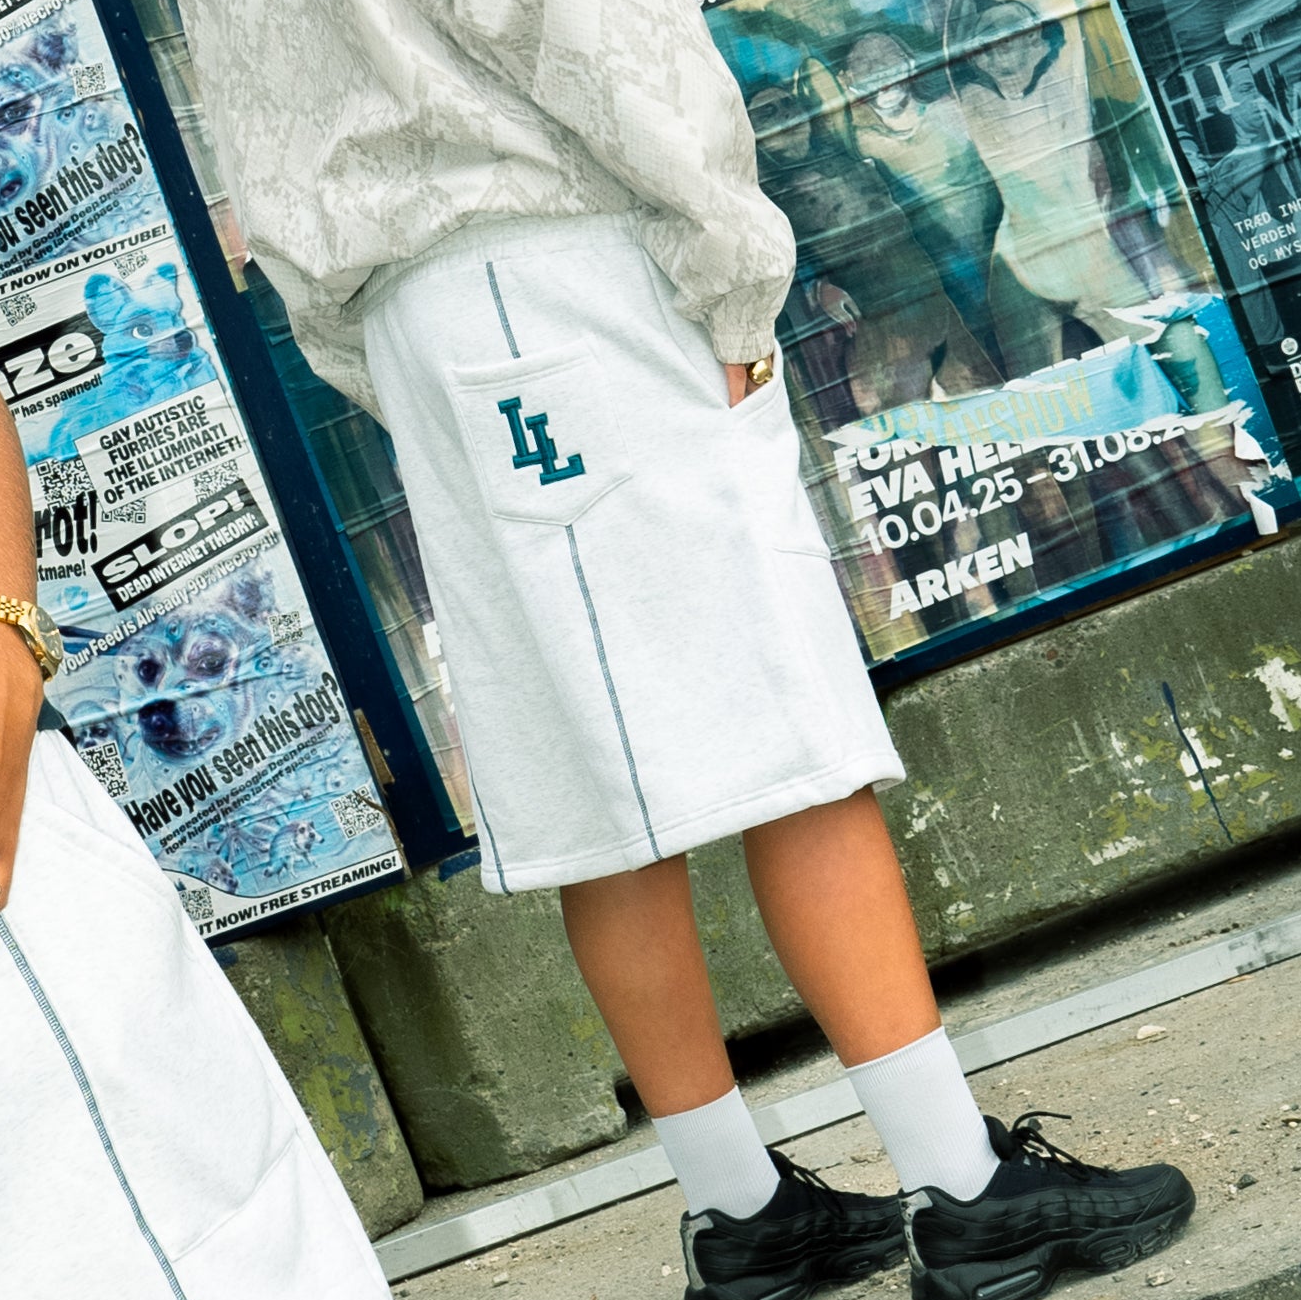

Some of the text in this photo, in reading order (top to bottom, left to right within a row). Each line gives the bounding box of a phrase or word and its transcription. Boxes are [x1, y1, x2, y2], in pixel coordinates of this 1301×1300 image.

[848, 460, 936, 522] EVA
[861, 467, 1024, 557] 10.04.25
[101, 490, 246, 585] SLOP!
[889, 532, 1034, 621] ARKEN
[216, 855, 396, 929] NOW! FREE STREAMING!
